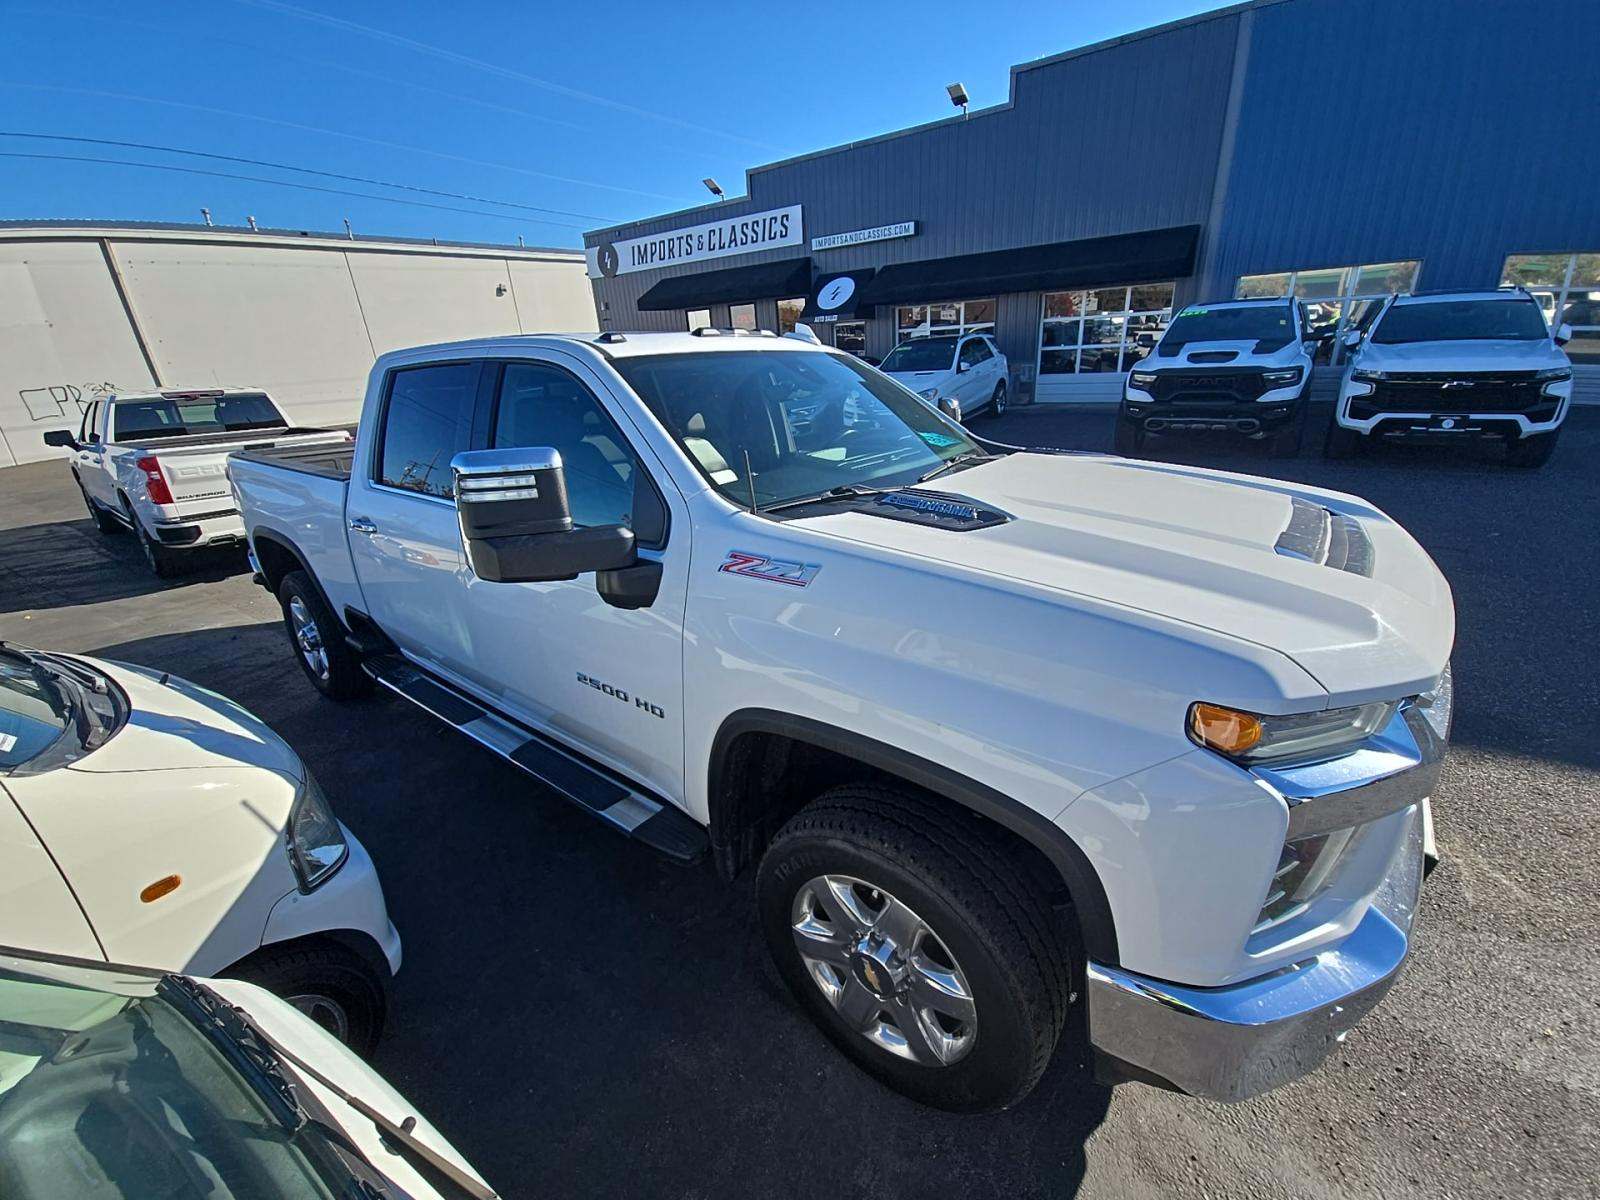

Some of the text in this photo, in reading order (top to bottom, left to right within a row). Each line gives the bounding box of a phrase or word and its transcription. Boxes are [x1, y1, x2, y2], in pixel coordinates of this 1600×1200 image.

[631, 213, 790, 267] IMPORTS & CLASSICS
[814, 223, 911, 248] IMPORTSANDCLASSICS.COM
[718, 551, 822, 588] Z71
[576, 671, 664, 718] 2500 HD
